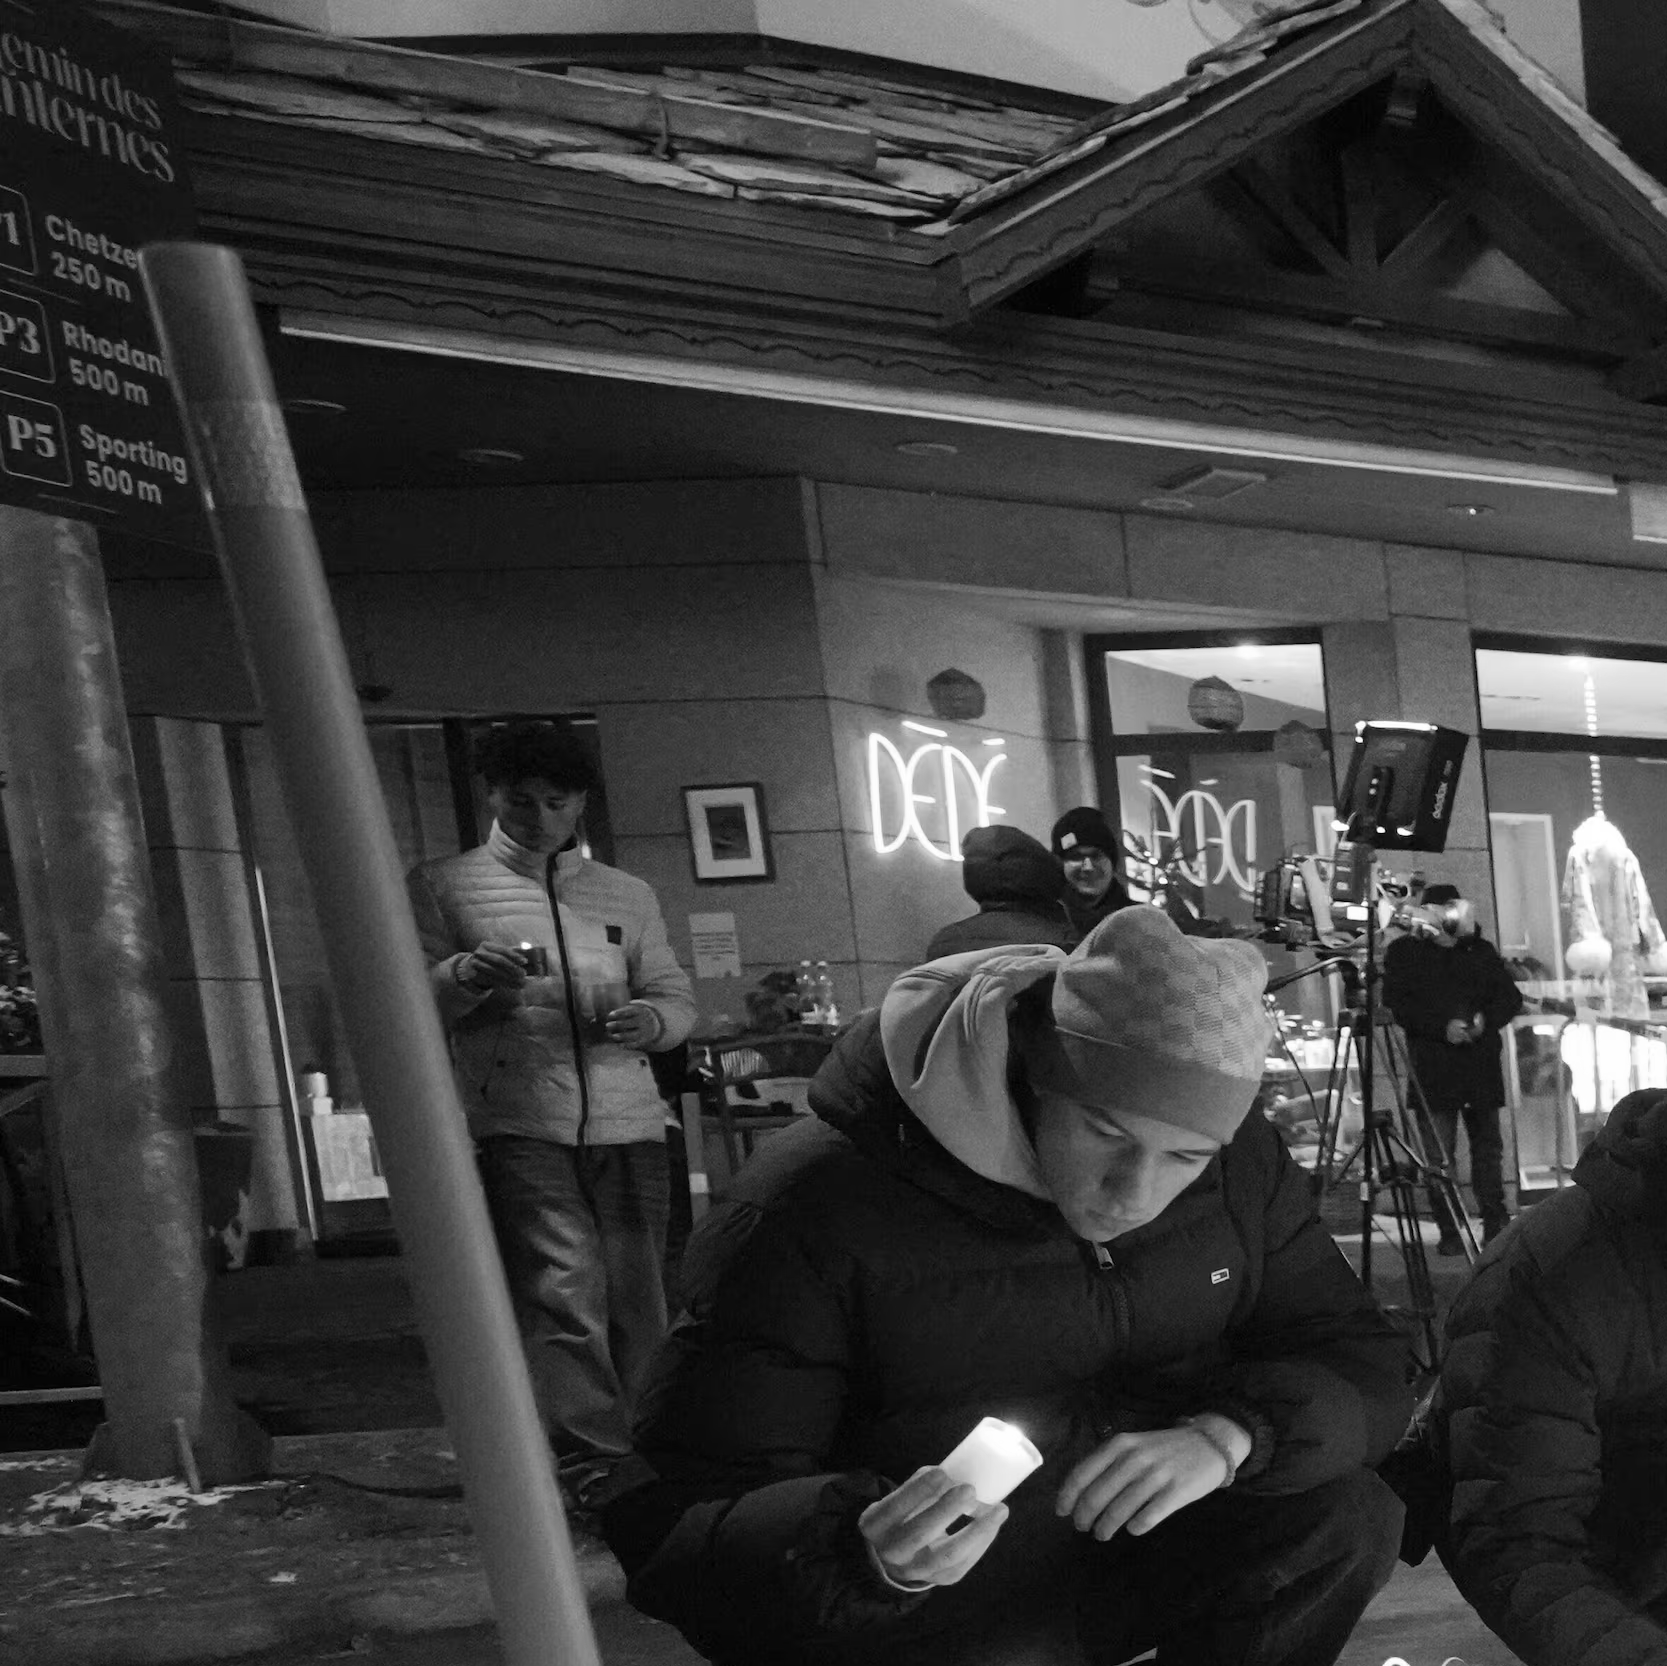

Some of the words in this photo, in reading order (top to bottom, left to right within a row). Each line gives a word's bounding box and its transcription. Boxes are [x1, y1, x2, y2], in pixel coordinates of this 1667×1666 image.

[0, 32, 97, 102] emin
[101, 73, 162, 129] des
[0, 74, 175, 183] nternes
[0, 211, 21, 246] 1
[45, 214, 138, 270] Chetze
[51, 251, 101, 290] 250
[104, 275, 131, 303] m
[69, 356, 120, 396] 500
[123, 380, 149, 406] m
[8, 414, 57, 458] P5
[79, 423, 188, 485] Sporting
[85, 459, 133, 496] 500
[137, 480, 162, 505] m
